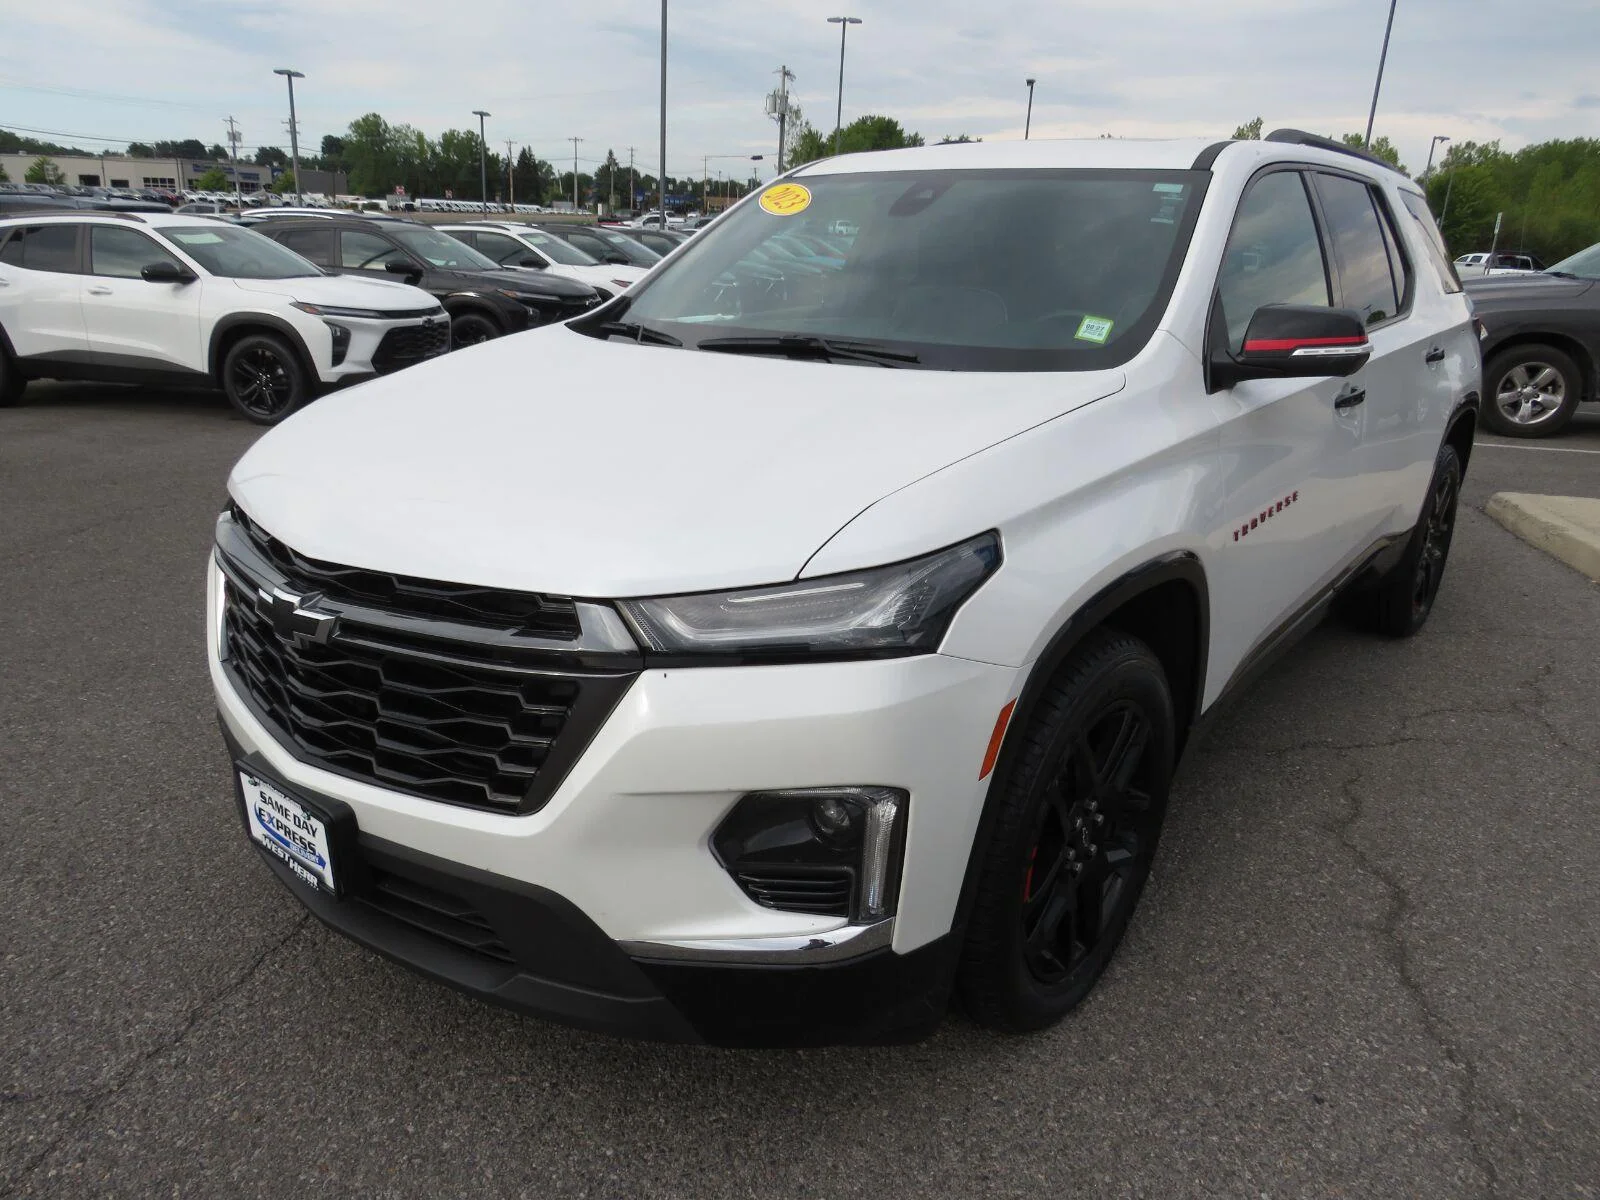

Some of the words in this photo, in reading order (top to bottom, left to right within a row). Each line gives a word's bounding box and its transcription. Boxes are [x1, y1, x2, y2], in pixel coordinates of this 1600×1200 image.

[1233, 490, 1298, 542] TRAVERSE
[258, 806, 317, 856] EXPRESS
[259, 790, 291, 823] SAME
[293, 813, 318, 838] DAY
[262, 834, 290, 863] WEST
